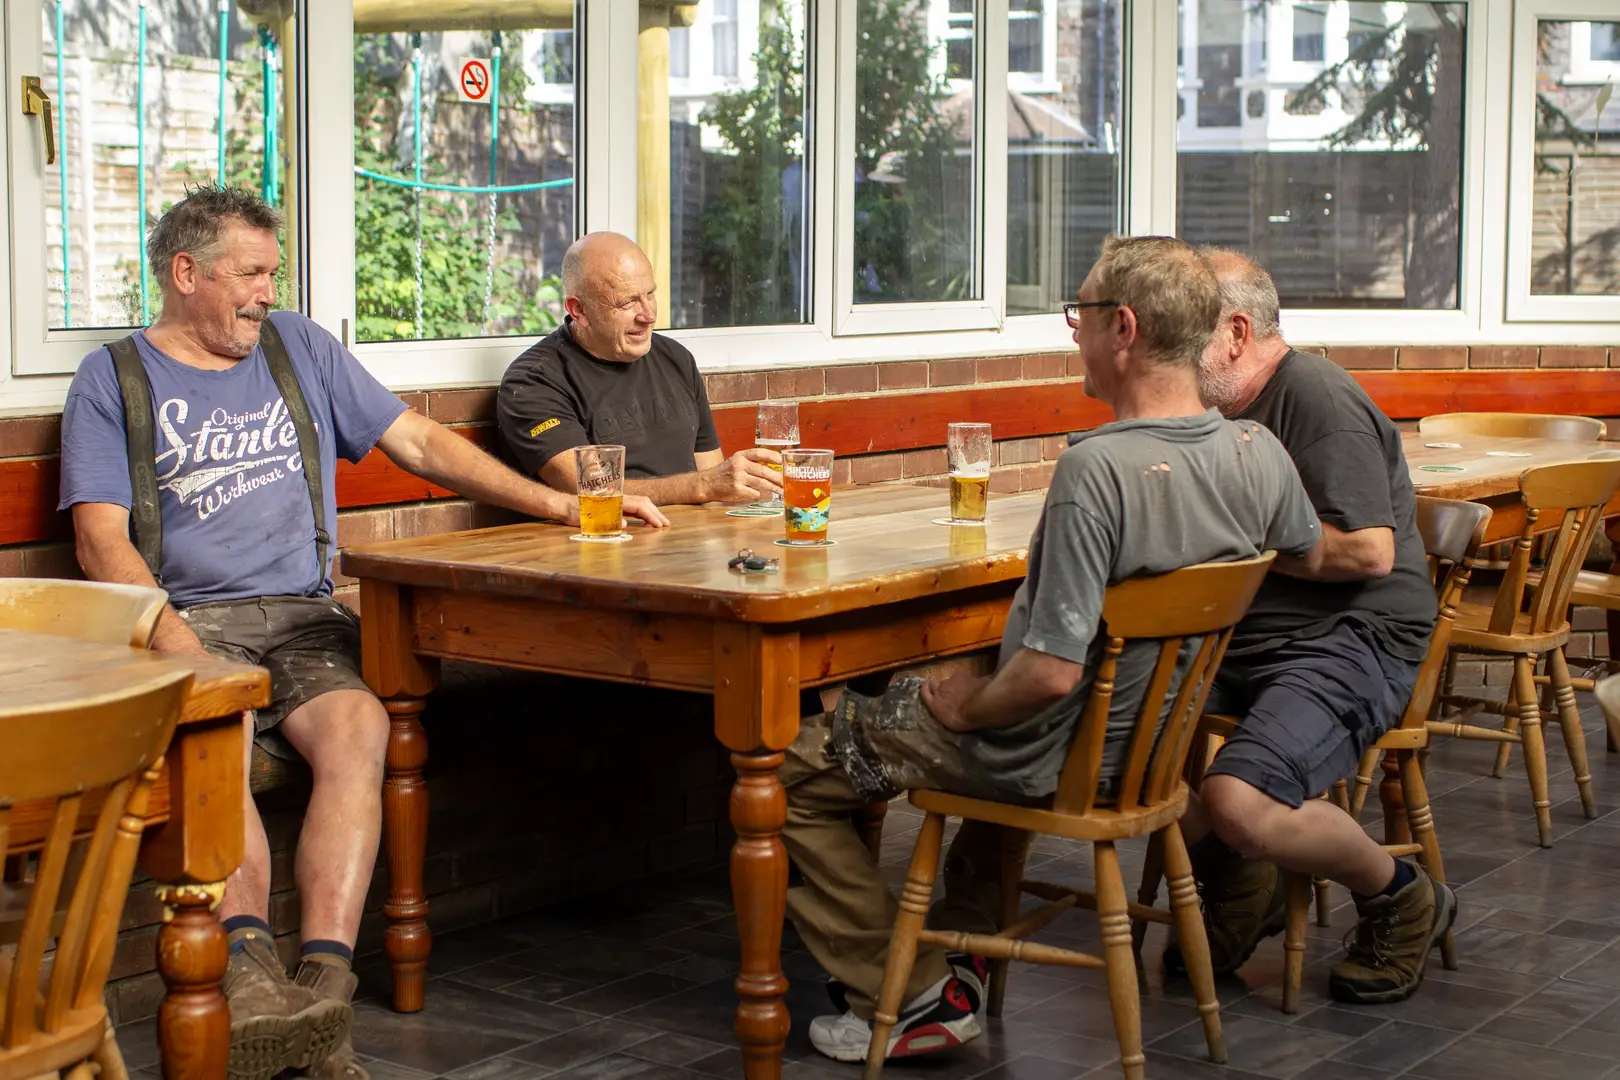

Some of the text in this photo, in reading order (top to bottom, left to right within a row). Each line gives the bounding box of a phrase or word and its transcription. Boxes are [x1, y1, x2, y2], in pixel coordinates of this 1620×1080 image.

[211, 401, 271, 430] Original
[155, 397, 303, 480] Stanle
[190, 470, 285, 521] Workwear
[578, 471, 621, 490] THATCHERS
